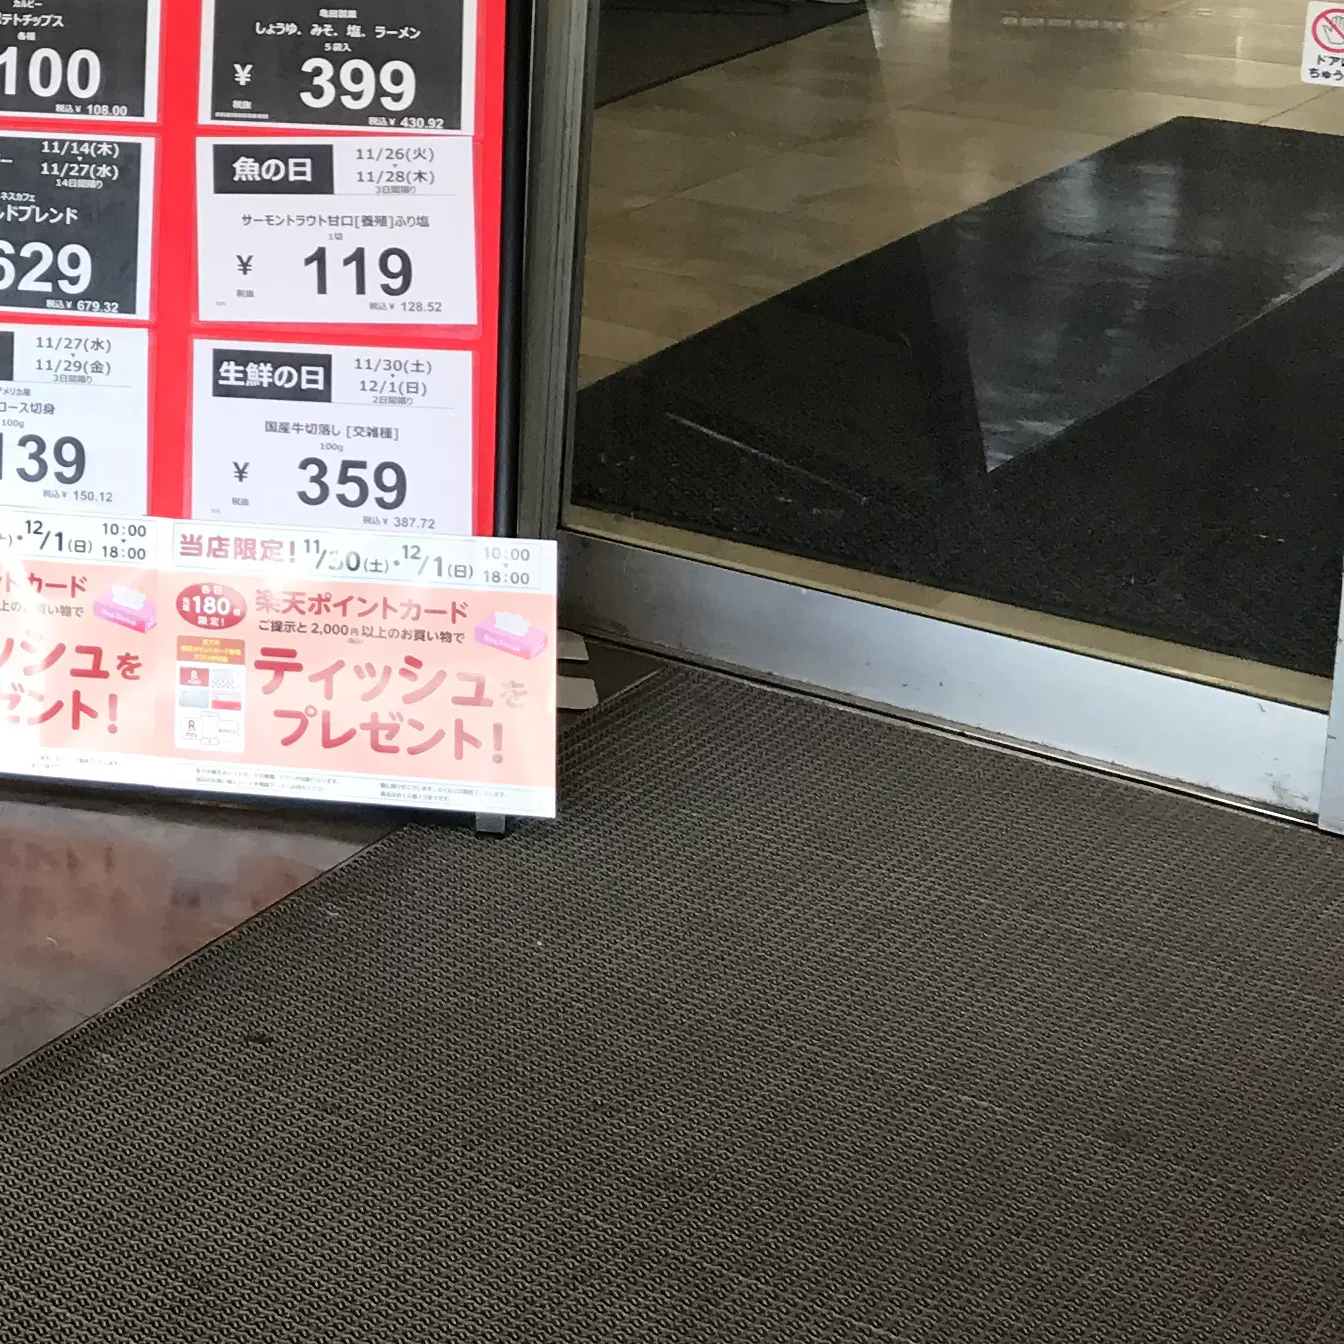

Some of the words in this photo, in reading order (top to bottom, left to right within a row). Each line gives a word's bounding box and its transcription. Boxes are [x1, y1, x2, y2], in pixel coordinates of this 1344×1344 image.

[299, 57, 416, 112] 399
[86, 104, 128, 116] 108.00
[400, 117, 444, 129] 430.92
[41, 140, 120, 157] 11/14(木)
[356, 148, 434, 162] 11/26(火)
[40, 163, 119, 180] 11/27(水)
[232, 156, 312, 183] 魚の日
[356, 170, 435, 184] 11/28(木)
[303, 246, 412, 296] 119
[76, 300, 119, 314] 679.32
[400, 302, 442, 312] 128.52
[36, 337, 112, 352] 11/27(水)
[35, 359, 111, 375] 11/29(金)
[354, 358, 432, 374] 11/30(土)
[218, 361, 325, 391] 生鮮の日
[359, 380, 427, 396] 12/1(日)
[296, 457, 407, 510] 359
[73, 490, 112, 502] 150.12
[102, 522, 147, 537] 10:00
[394, 517, 435, 529] 387.72
[101, 546, 146, 560] 18:00
[484, 546, 530, 562] 10:00
[483, 570, 530, 585] 18:00
[256, 589, 469, 624] 楽天ポイントカード
[254, 647, 528, 709] ティッシュを
[273, 705, 504, 764] プレゼント!
